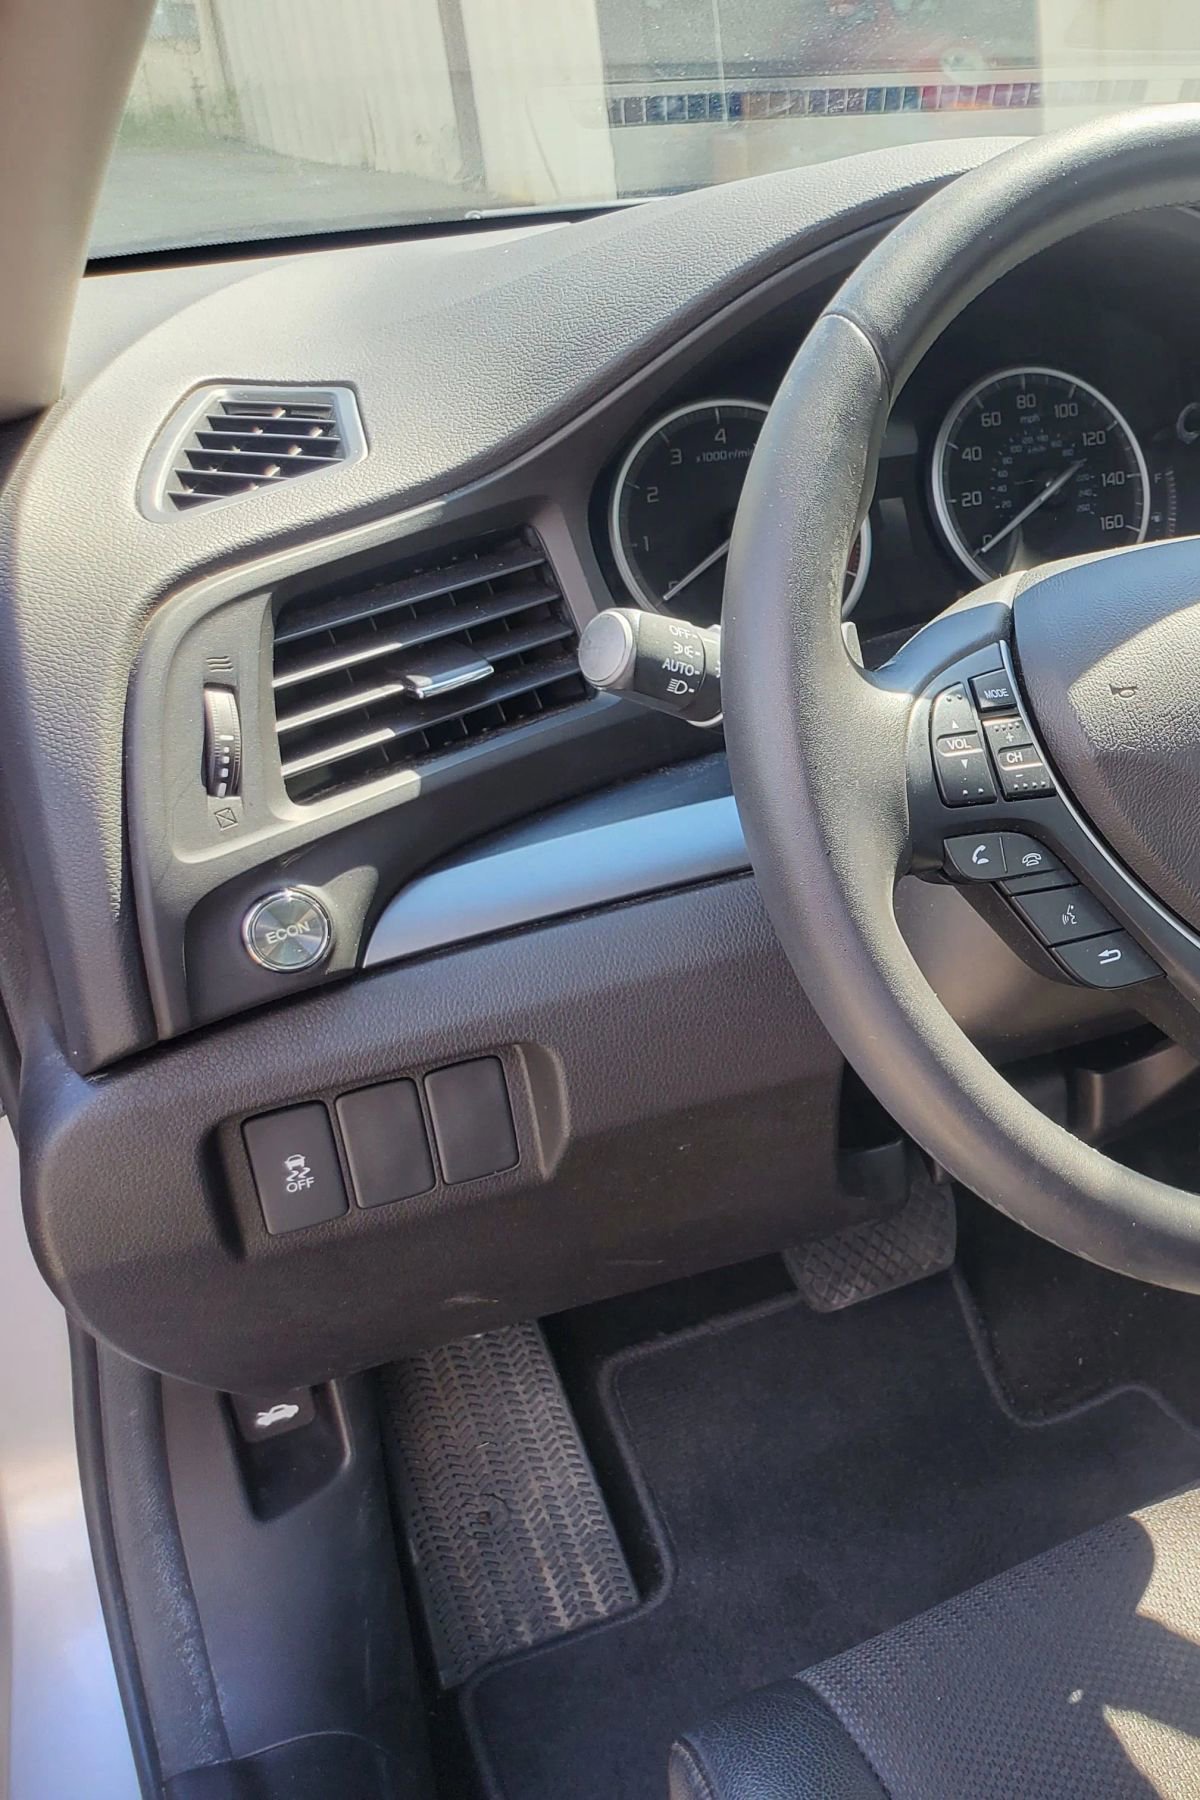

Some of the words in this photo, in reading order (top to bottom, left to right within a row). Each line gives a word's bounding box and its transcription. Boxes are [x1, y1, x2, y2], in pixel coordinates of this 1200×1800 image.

[1016, 394, 1036, 408] 80
[1054, 403, 1078, 418] 100
[981, 412, 1001, 427] 60
[1020, 413, 1040, 424] mph
[714, 428, 727, 444] 4
[1082, 430, 1106, 446] 120
[670, 449, 682, 465] 3
[962, 447, 982, 461] 40
[1101, 471, 1125, 487] 140
[1154, 473, 1162, 484] F
[647, 486, 659, 503] 2
[962, 491, 982, 507] 20
[1100, 514, 1124, 530] 160
[643, 536, 650, 551] 1
[668, 625, 692, 640] OFF
[662, 657, 695, 677] AUTO
[984, 688, 1009, 699] MODE
[947, 738, 971, 750] VOL
[1006, 752, 1023, 763] CH
[265, 921, 311, 945] ECON
[286, 1177, 315, 1193] OFF
